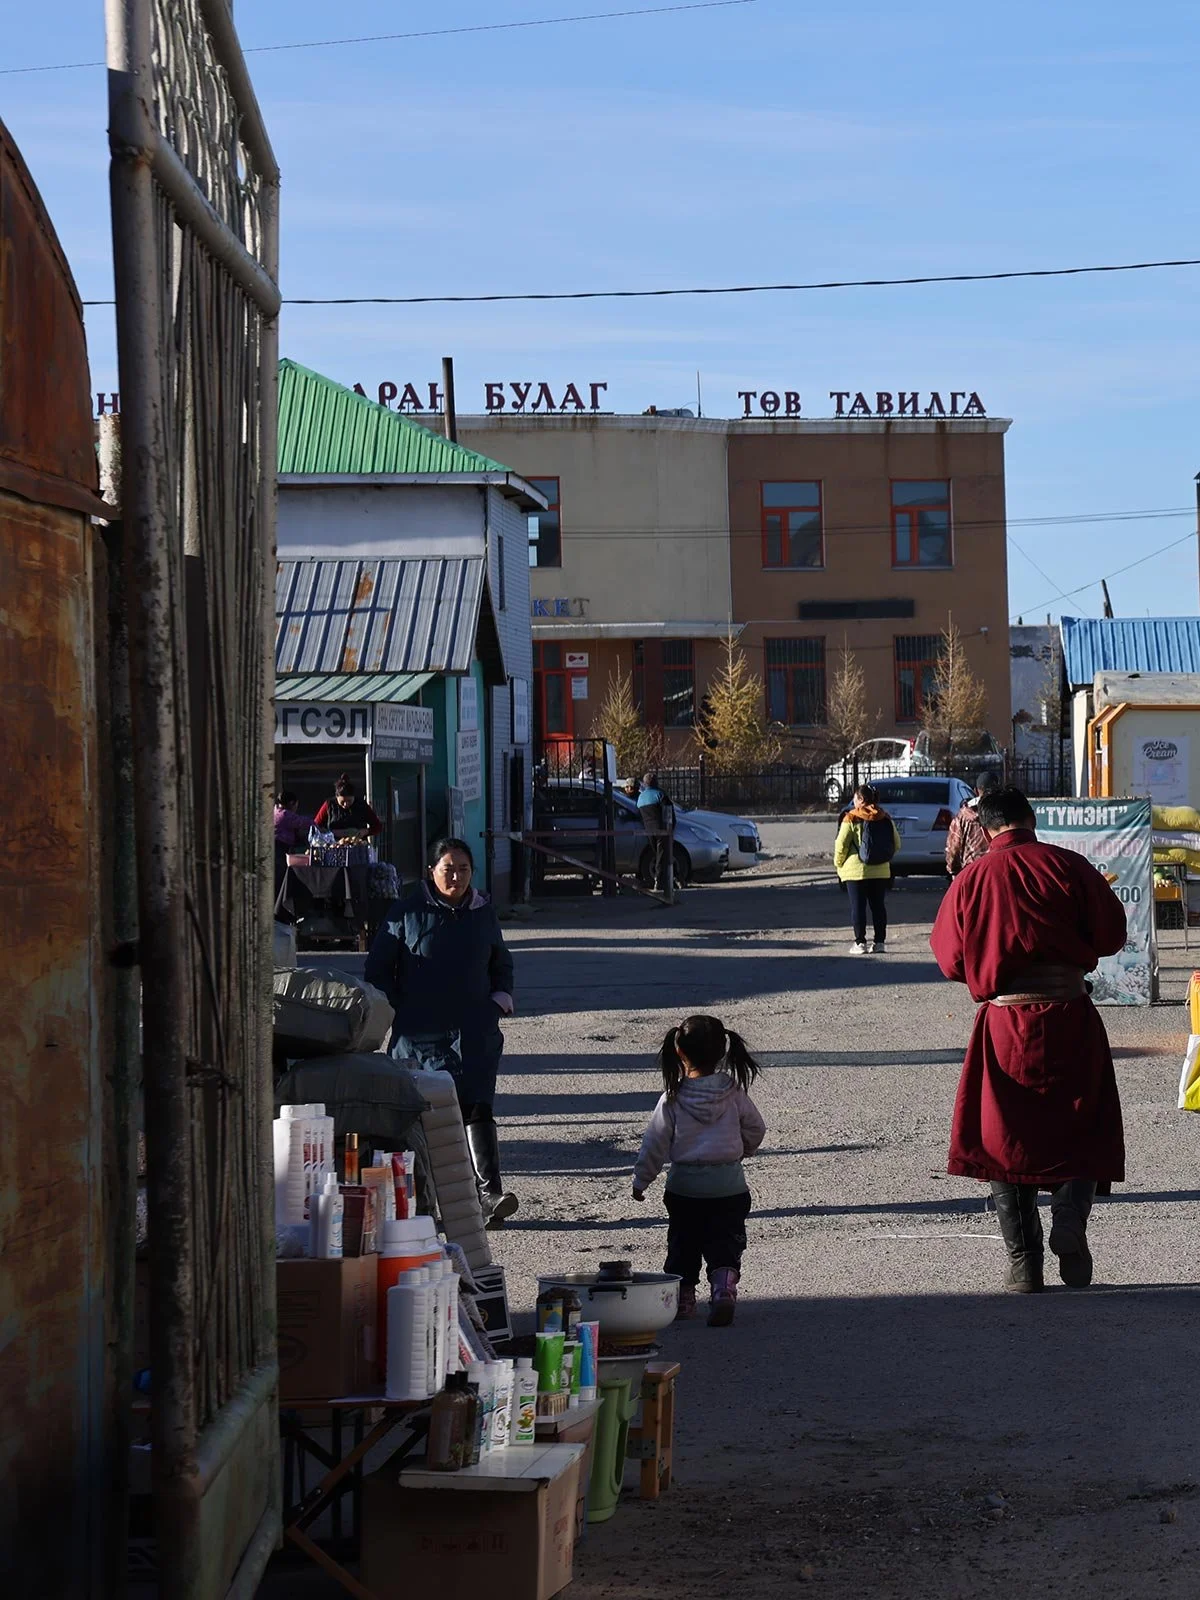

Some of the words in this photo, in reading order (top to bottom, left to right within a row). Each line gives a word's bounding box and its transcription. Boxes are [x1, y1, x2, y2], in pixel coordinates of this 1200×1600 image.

[484, 382, 608, 410] БУЛАГ
[738, 391, 801, 414] ТӨВ
[830, 391, 986, 414] ТАВИЛГА
[275, 707, 368, 738] ГСЭЛ
[1143, 747, 1176, 758] Cream
[1152, 740, 1169, 750] Ice
